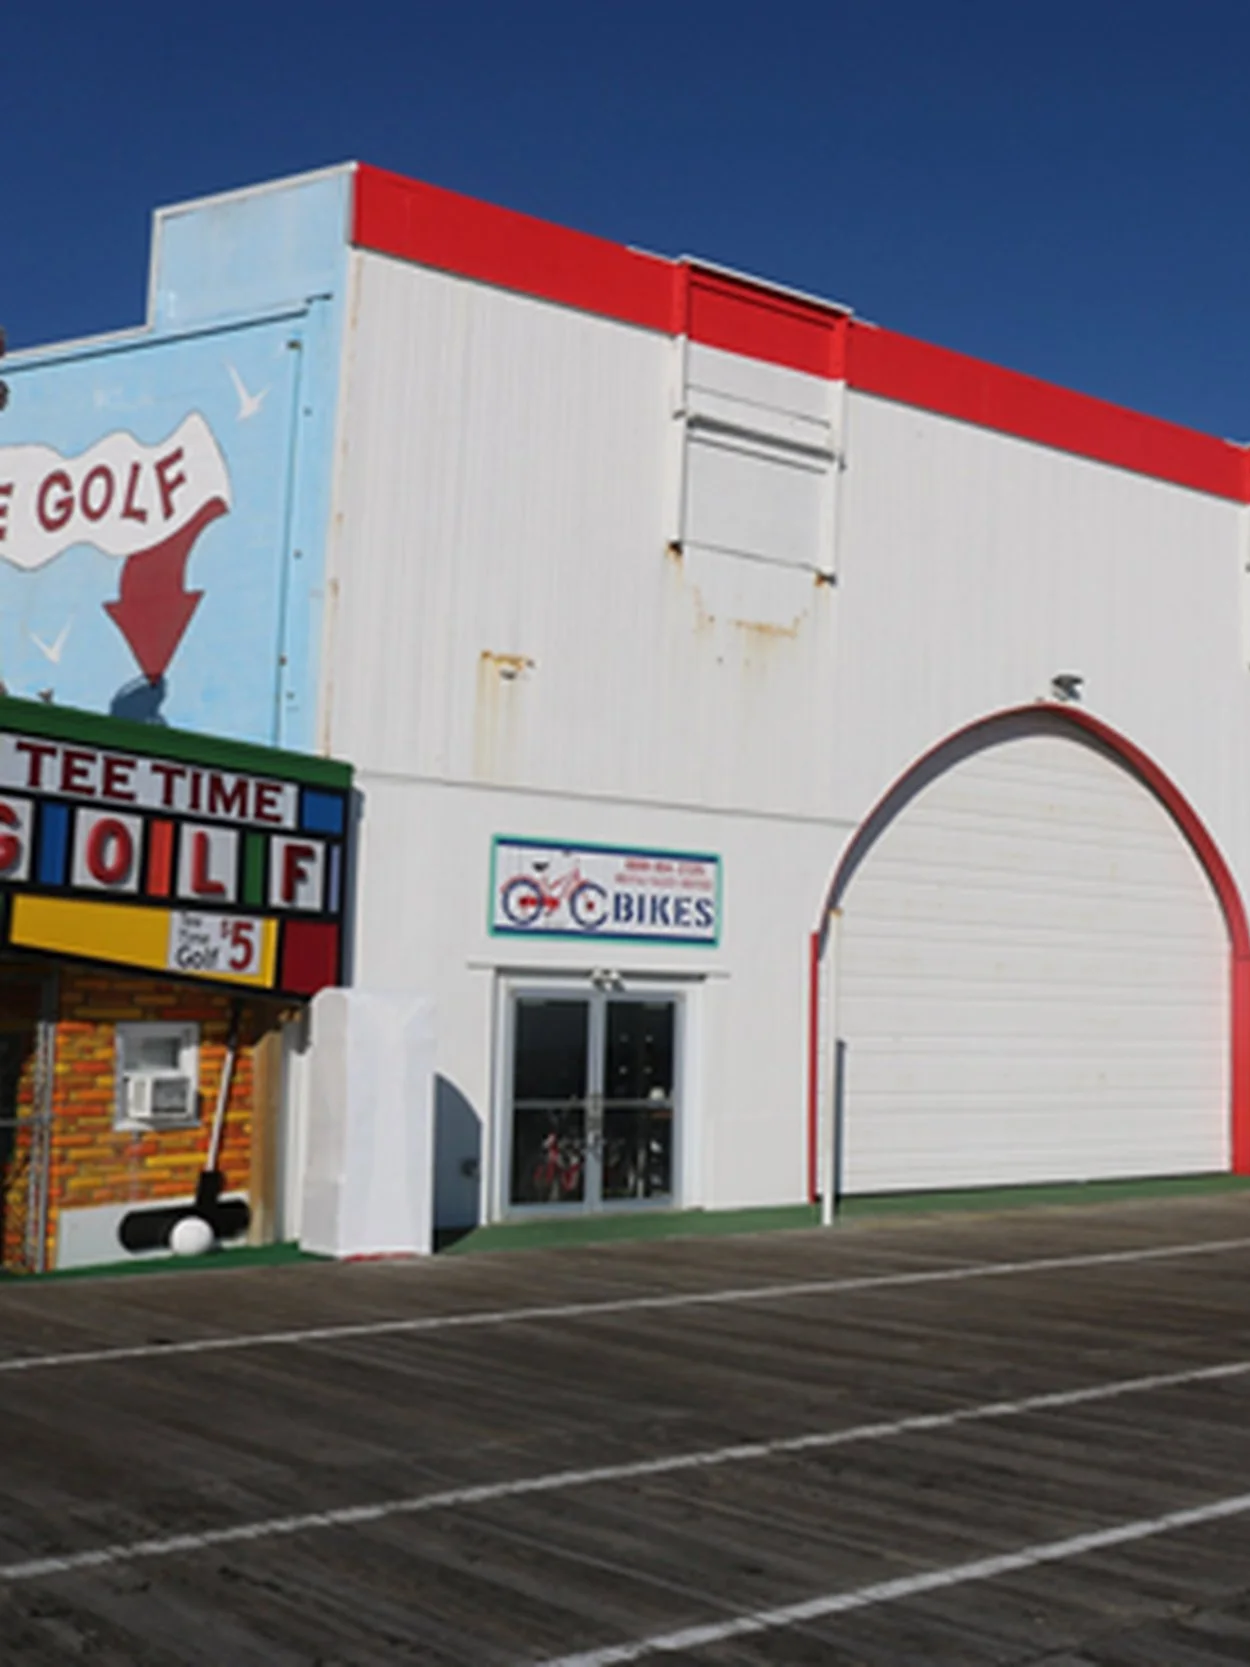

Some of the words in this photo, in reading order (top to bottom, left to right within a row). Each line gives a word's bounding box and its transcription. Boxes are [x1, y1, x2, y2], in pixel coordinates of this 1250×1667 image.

[37, 448, 187, 533] GOLF
[15, 741, 138, 801] TEE
[151, 763, 285, 824] TIME
[613, 892, 715, 928] BIKES
